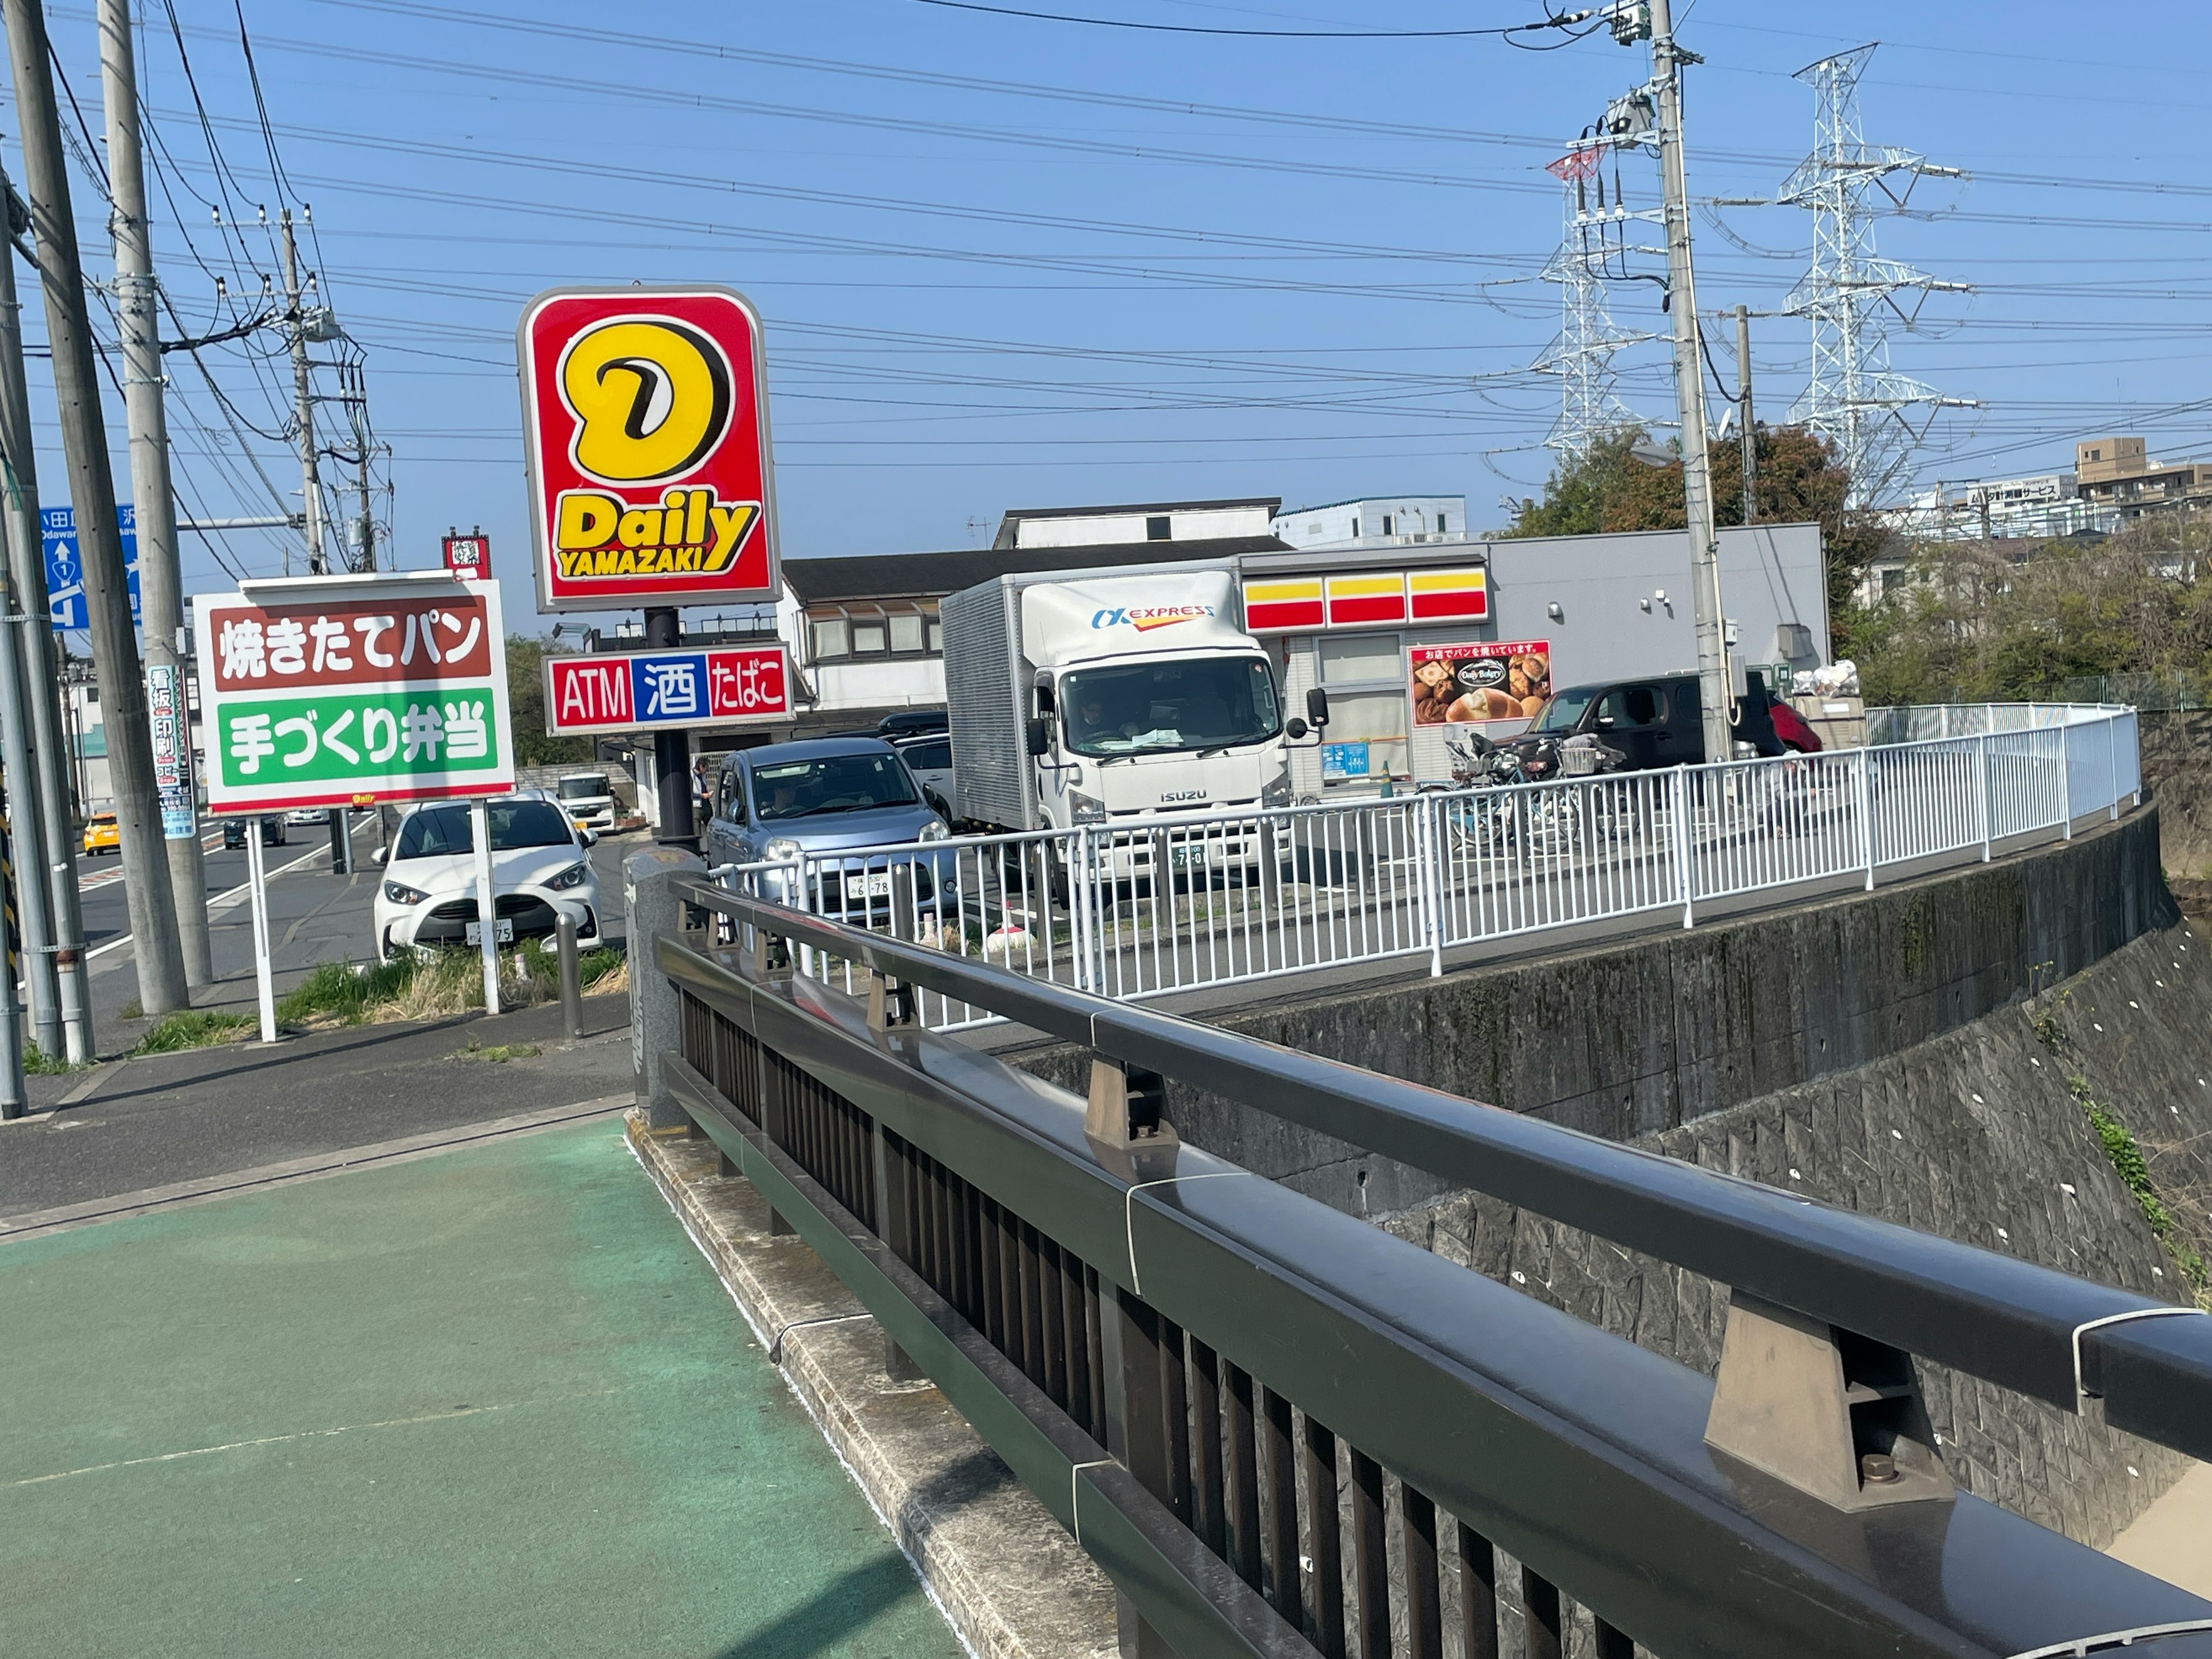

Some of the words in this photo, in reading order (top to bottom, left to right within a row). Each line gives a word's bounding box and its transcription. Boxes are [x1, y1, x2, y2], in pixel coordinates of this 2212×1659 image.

[559, 490, 760, 571] Daily
[60, 564, 67, 576] 1
[559, 548, 703, 576] YAMAZAKI
[1129, 605, 1215, 619] EXPRESS
[220, 609, 480, 680] 焼きたてパン
[151, 669, 172, 708] 看板
[562, 668, 627, 720] ATM
[645, 663, 696, 715] 酒
[713, 660, 783, 709] たばこ
[154, 718, 175, 757] 印刷
[230, 700, 487, 775] 手づくり弁当
[1161, 790, 1207, 802] ISUZU
